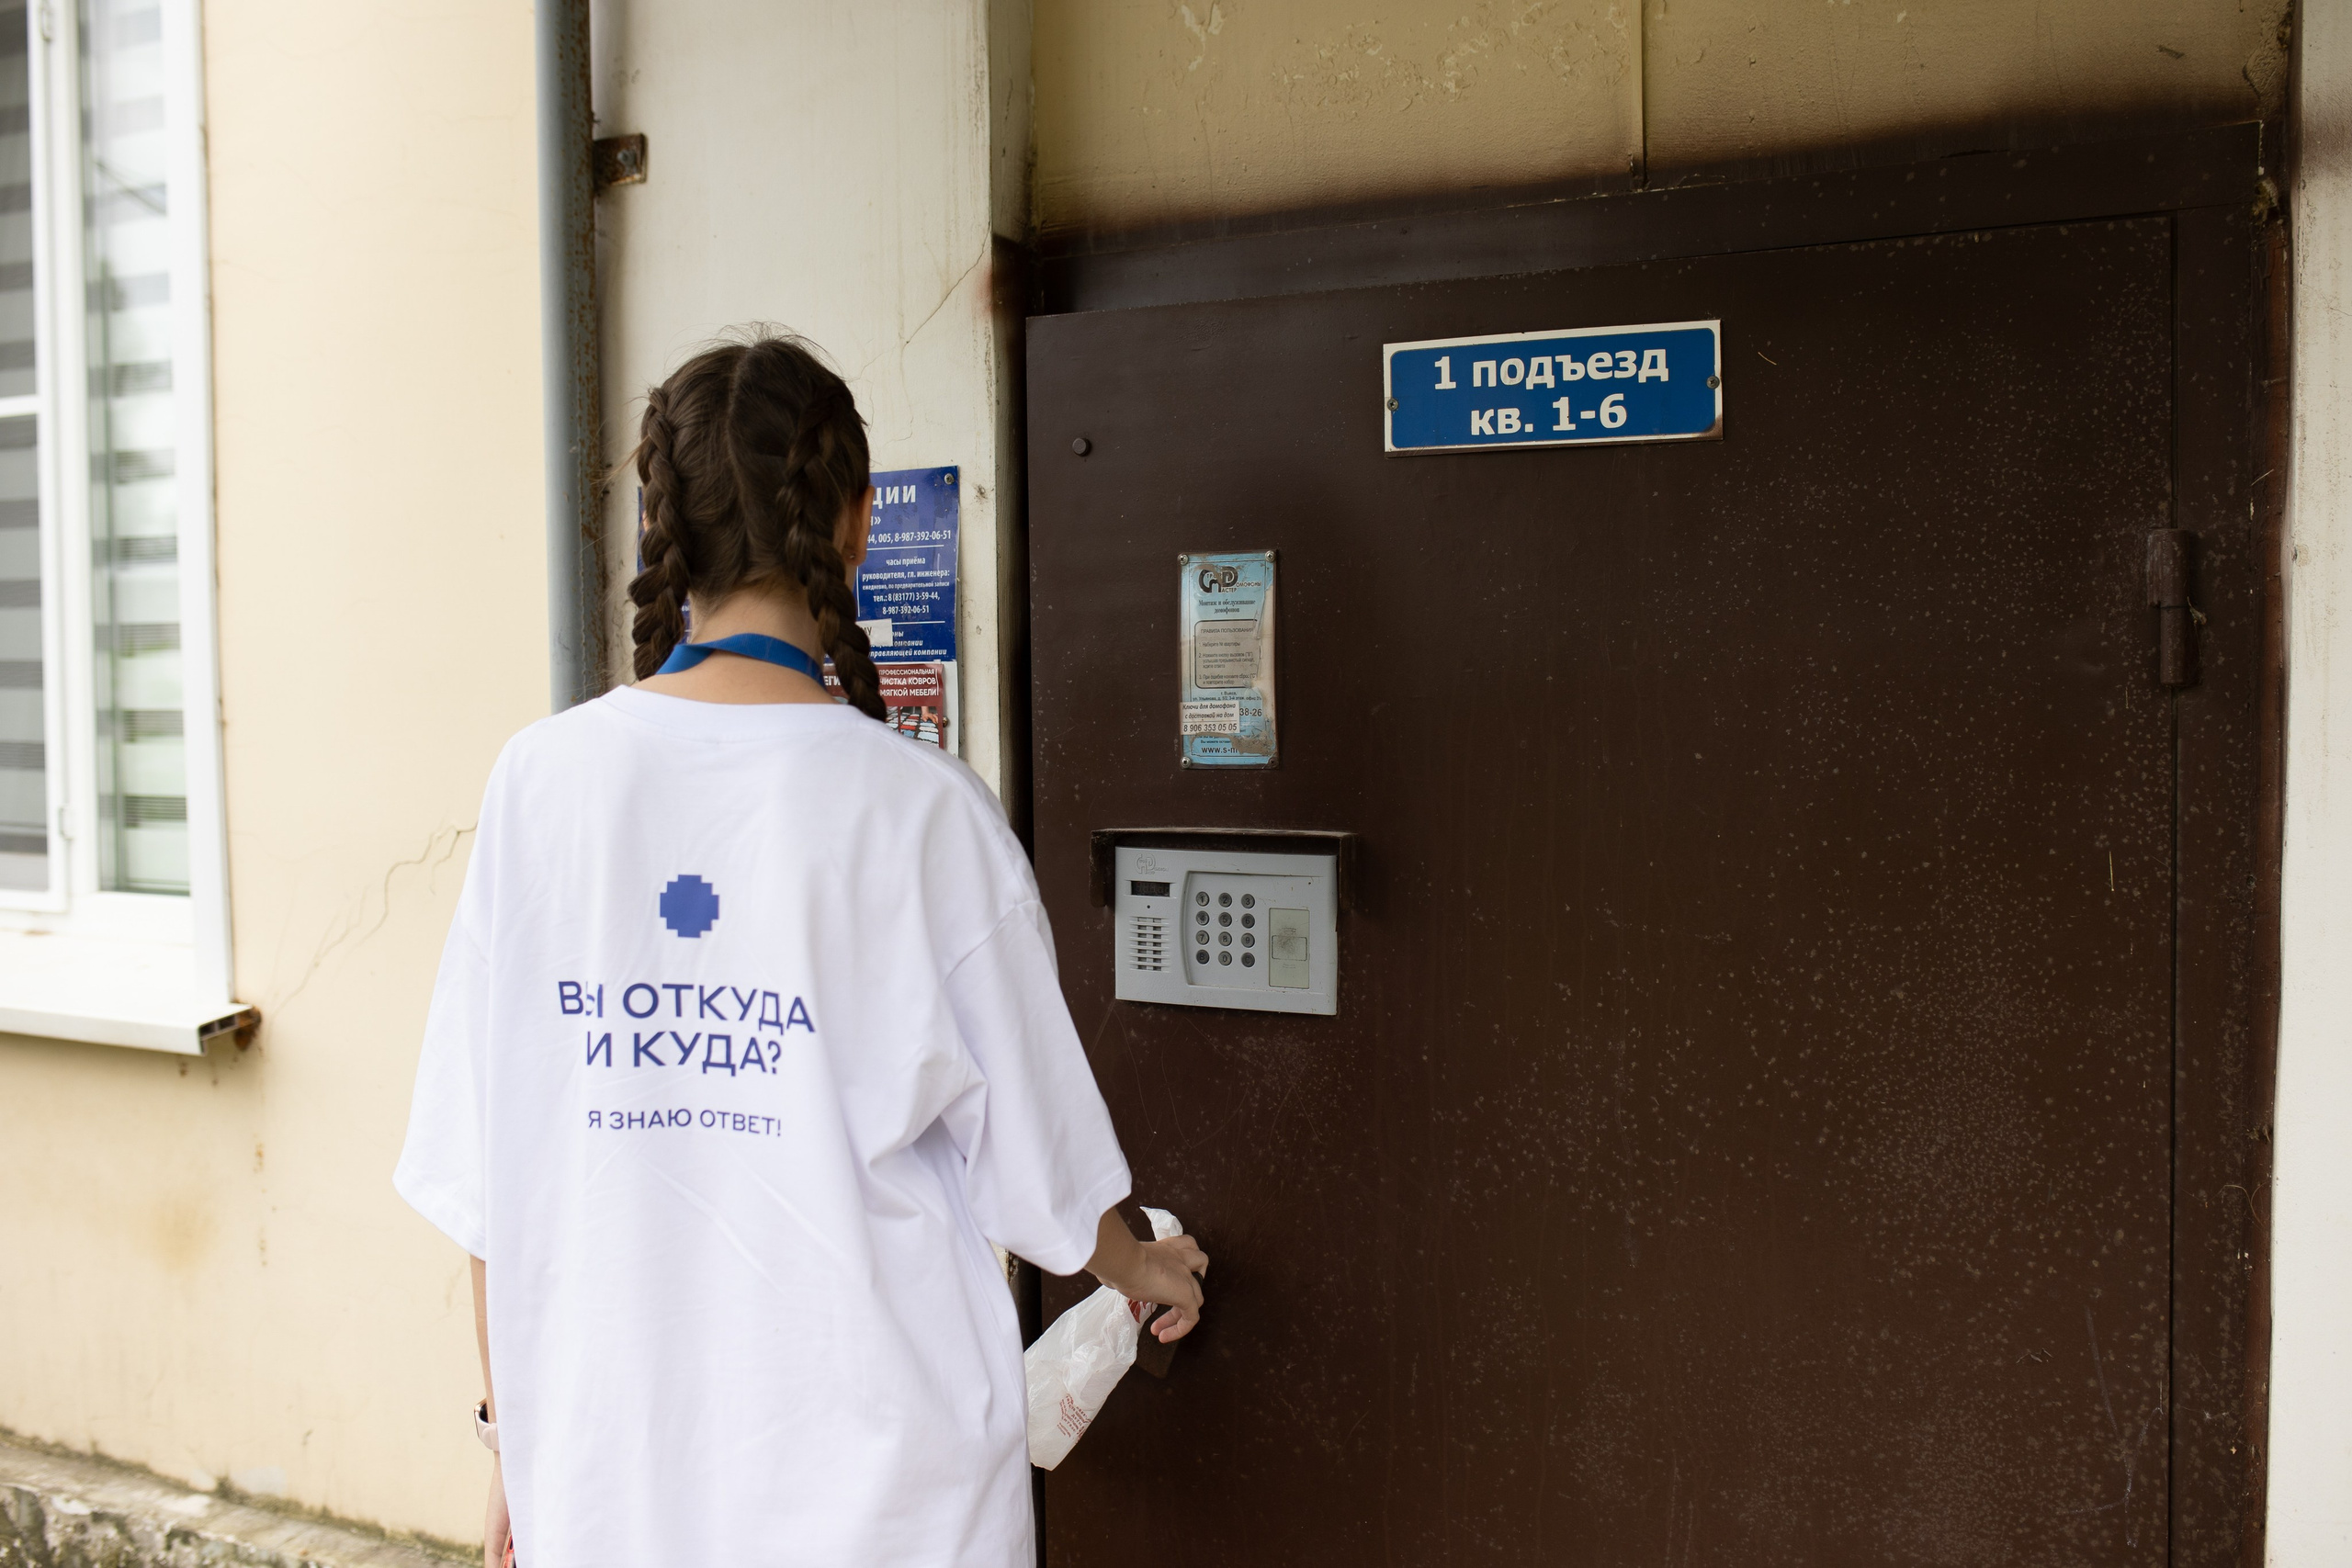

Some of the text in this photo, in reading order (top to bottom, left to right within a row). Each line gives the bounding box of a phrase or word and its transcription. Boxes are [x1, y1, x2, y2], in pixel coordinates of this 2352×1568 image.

[1434, 348, 1669, 390] 1 подъезд
[1471, 393, 1627, 435] кв. 1-6
[878, 533, 894, 544] 005,
[894, 530, 951, 543] 8-987-392-06-51
[902, 557, 926, 567] приёма
[862, 571, 907, 581] руководителя,
[917, 570, 950, 579] инженера:
[894, 581, 933, 590] предварительной
[888, 593, 892, 602] 8
[892, 592, 915, 603] (83177)
[916, 592, 940, 601] 3-59-44,
[882, 605, 930, 615] 8-987-392-06-51
[880, 677, 907, 685] ЧИСТКА
[880, 687, 937, 696] МЯГКОЙ МЕБЕЛИ
[1183, 724, 1188, 732] 8
[1190, 724, 1203, 732] 906
[1204, 723, 1216, 731] 353
[1217, 723, 1227, 731] 05
[1227, 723, 1238, 731] 05
[558, 980, 816, 1035] ВЫ ОТКУДА
[587, 1031, 782, 1077] И КУДА?
[588, 1109, 781, 1137] Я ЗНАЮ ОТВЕТ!
